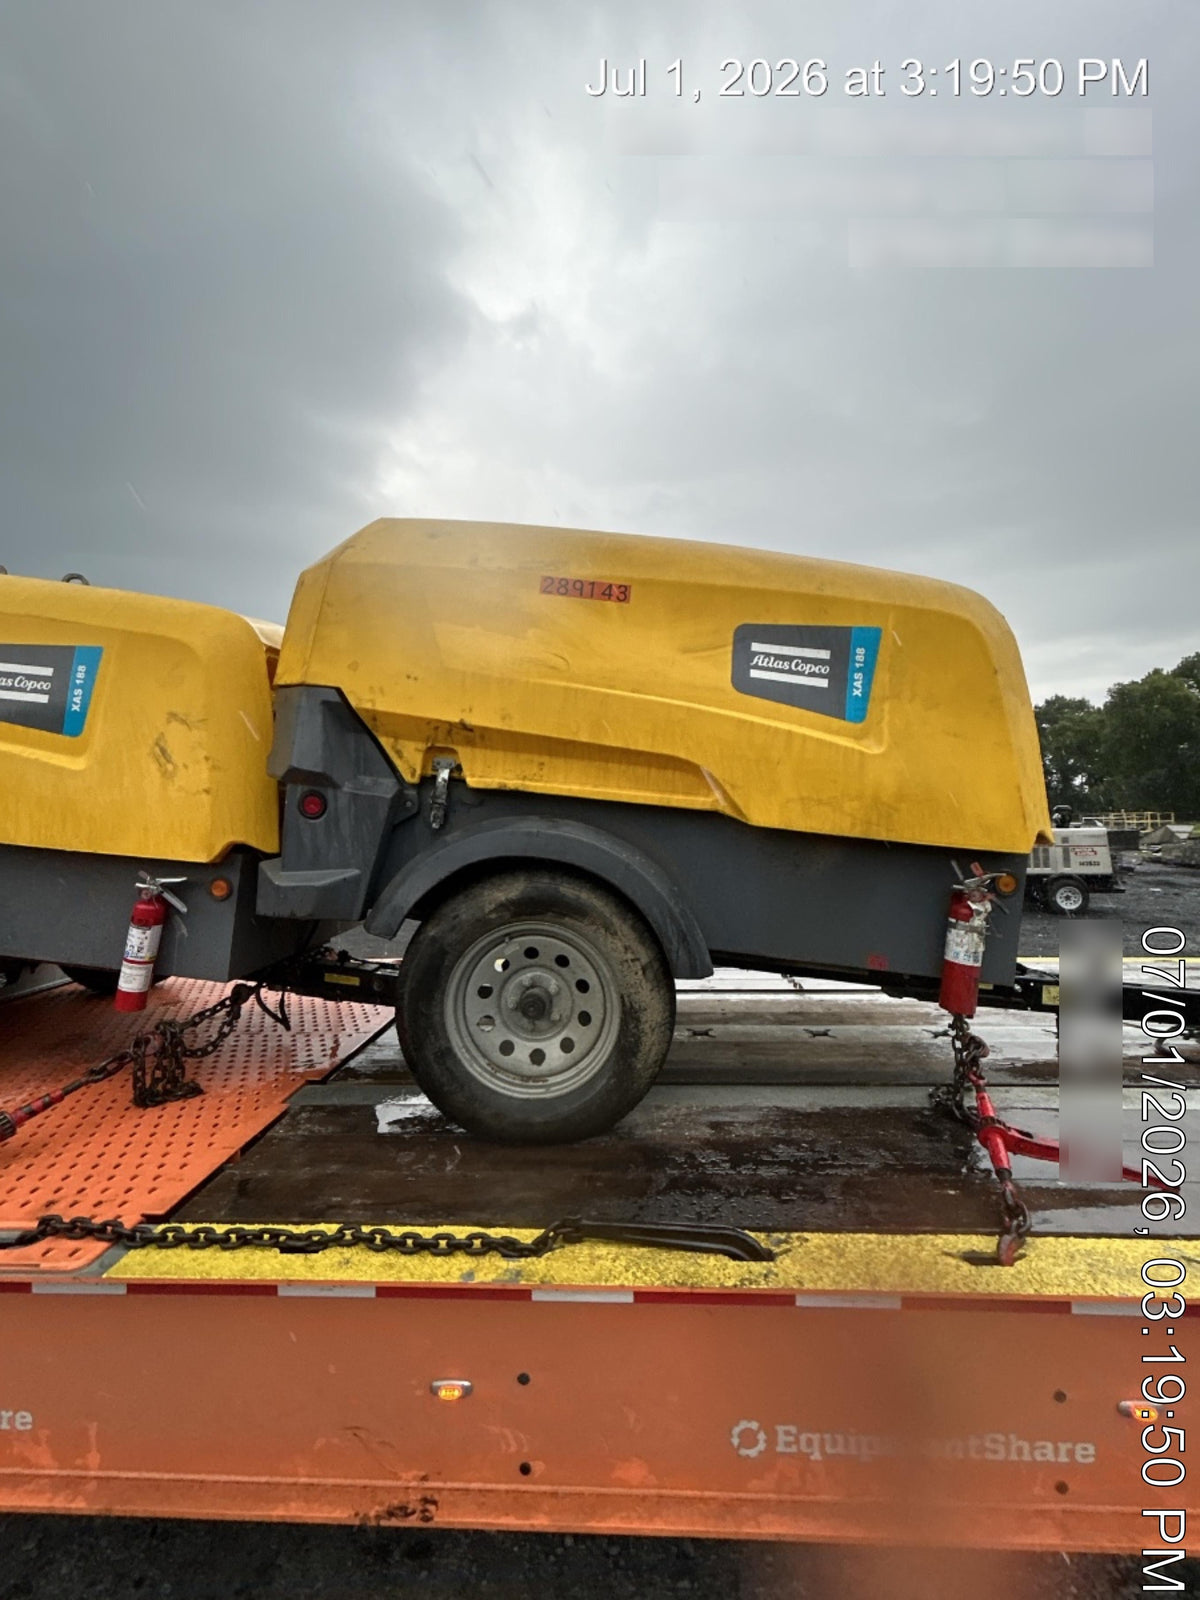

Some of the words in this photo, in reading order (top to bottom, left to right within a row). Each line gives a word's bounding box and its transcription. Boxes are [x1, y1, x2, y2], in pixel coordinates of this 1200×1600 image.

[541, 576, 628, 603] 289143
[750, 654, 790, 671] Atlas
[791, 658, 830, 676] Copco
[855, 647, 866, 668] 188
[14, 676, 51, 691] Copco
[75, 665, 86, 685] 188
[852, 672, 864, 698] XAS
[71, 689, 83, 712] XAS
